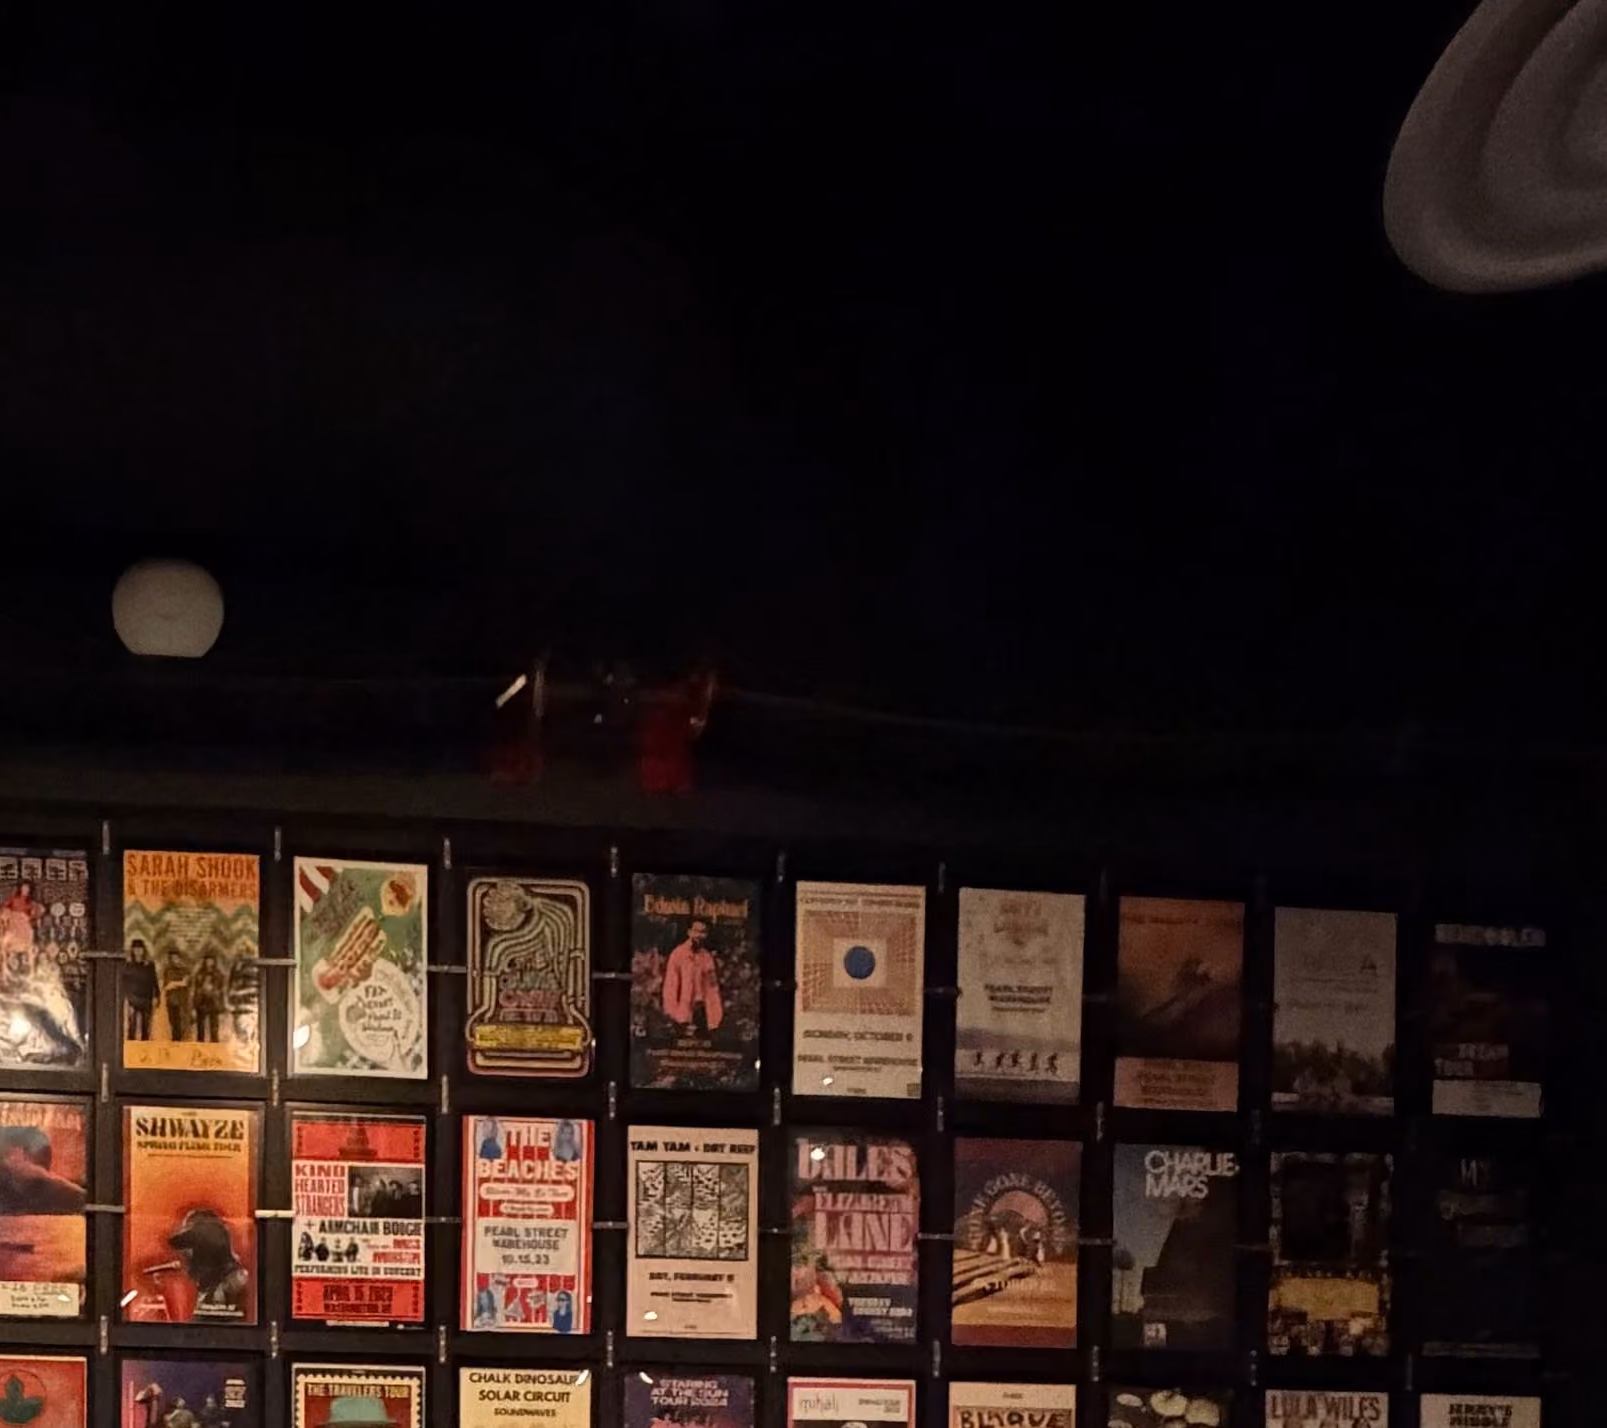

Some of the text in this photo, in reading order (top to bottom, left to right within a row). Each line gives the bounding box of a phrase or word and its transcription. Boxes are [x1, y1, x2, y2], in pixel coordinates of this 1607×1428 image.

[127, 853, 257, 880] SARAH SHOOK
[135, 1117, 245, 1141] SHWAYZE
[506, 1126, 551, 1146] THE
[295, 1165, 345, 1178] KIND
[478, 1159, 579, 1179] BEACHES
[295, 1178, 345, 1195] HEARTED
[1145, 1175, 1209, 1199] MARS
[295, 1195, 345, 1218] STRANGERS
[319, 1219, 380, 1235] ARMCHAIR
[484, 1226, 569, 1238] PEARL STREET
[492, 1238, 560, 1251] WAREHOUSE
[469, 1372, 511, 1384] CHALK
[306, 1383, 329, 1396] THE
[478, 1389, 571, 1403] SOLAR CIRCUIT
[651, 1396, 689, 1406] TOUR
